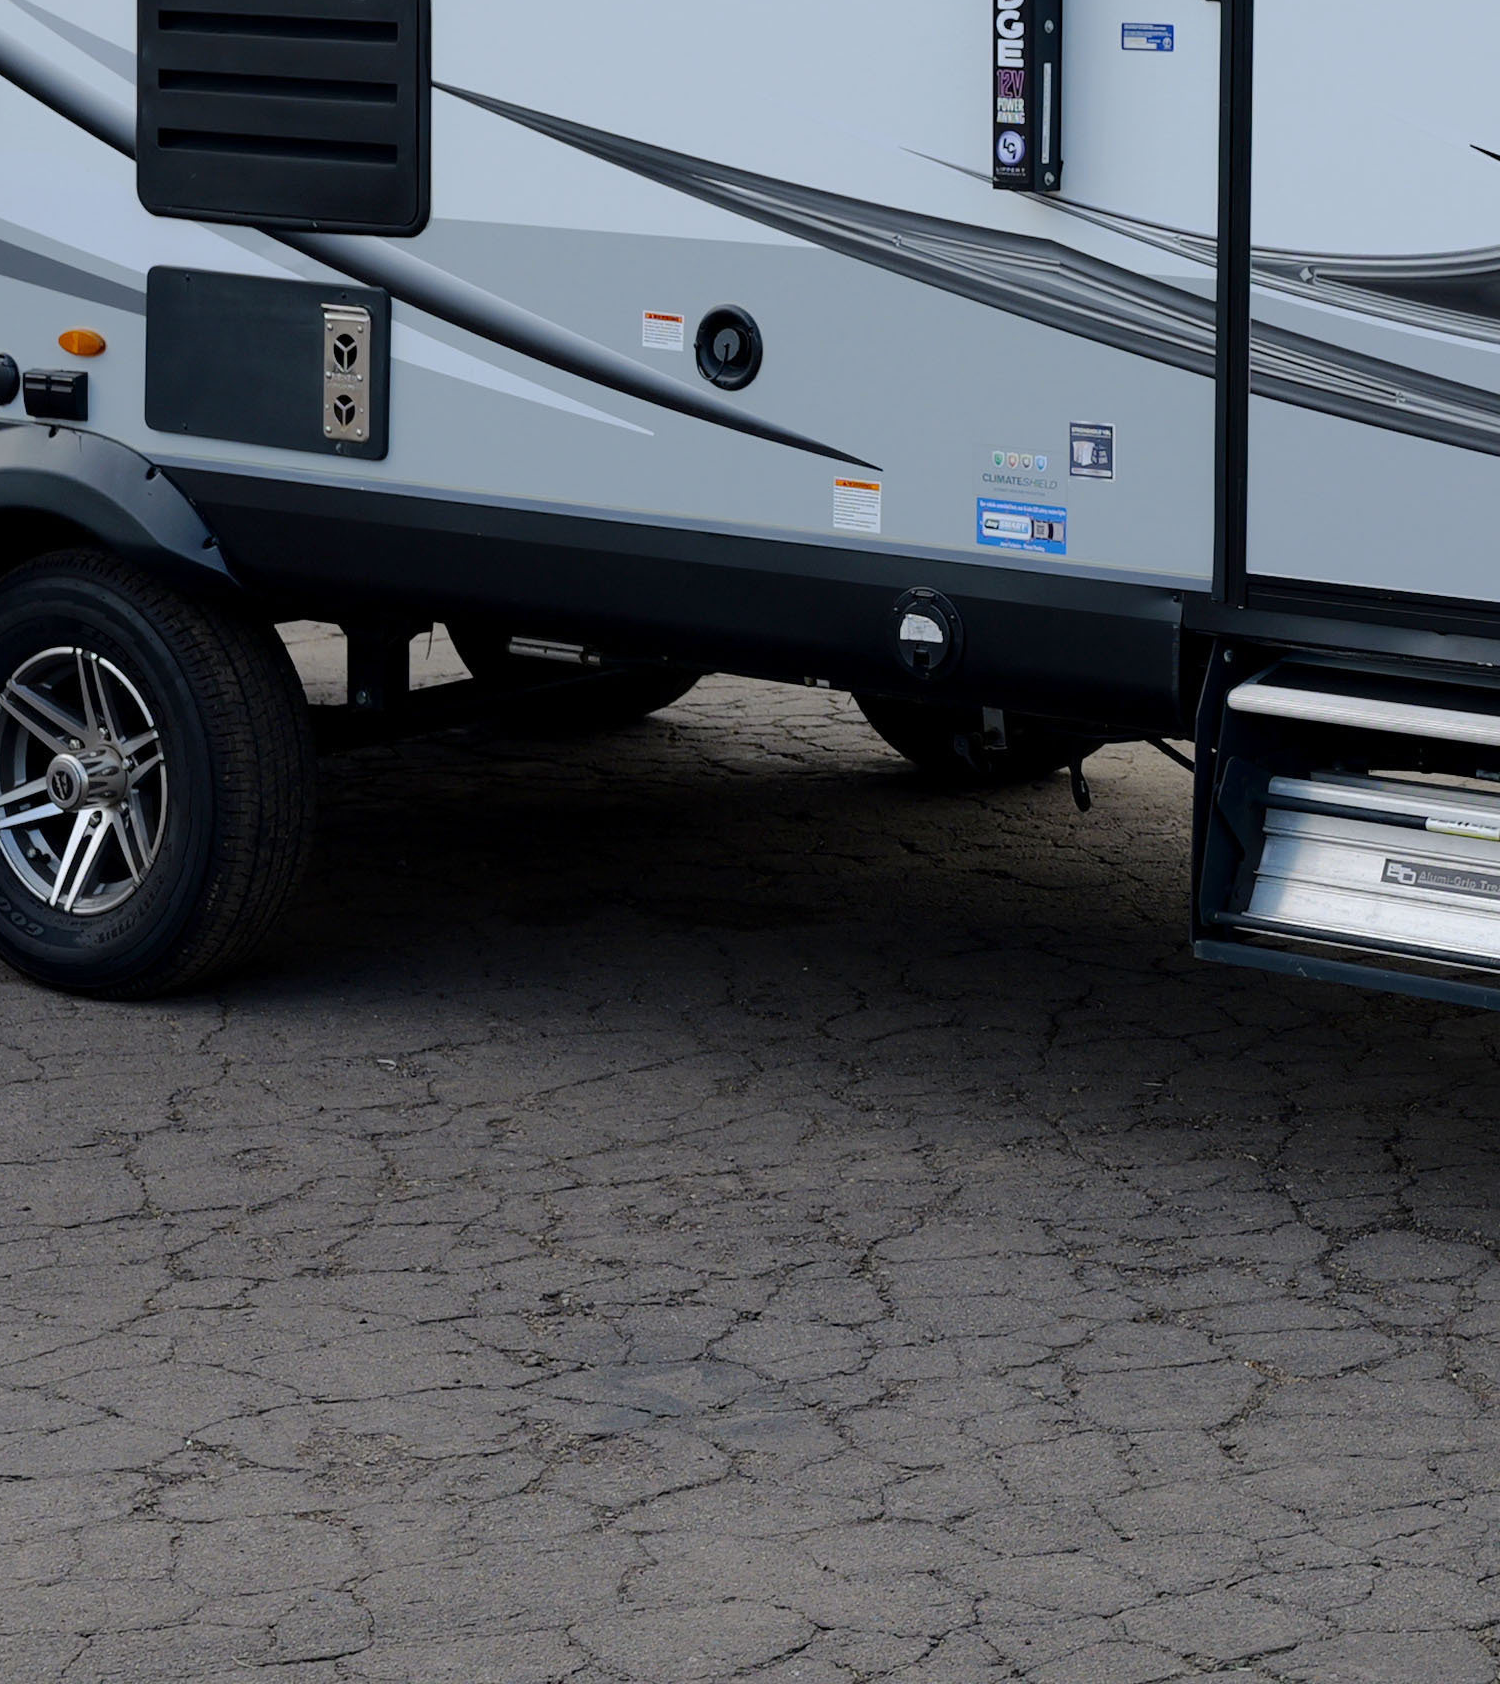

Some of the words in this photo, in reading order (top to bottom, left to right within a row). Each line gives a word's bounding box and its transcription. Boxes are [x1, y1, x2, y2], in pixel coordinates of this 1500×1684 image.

[996, 69, 1025, 98] 12V
[996, 97, 1025, 112] POWER
[982, 473, 1058, 489] CLIMATESHIELD
[1419, 871, 1477, 891] Alumi-Grip
